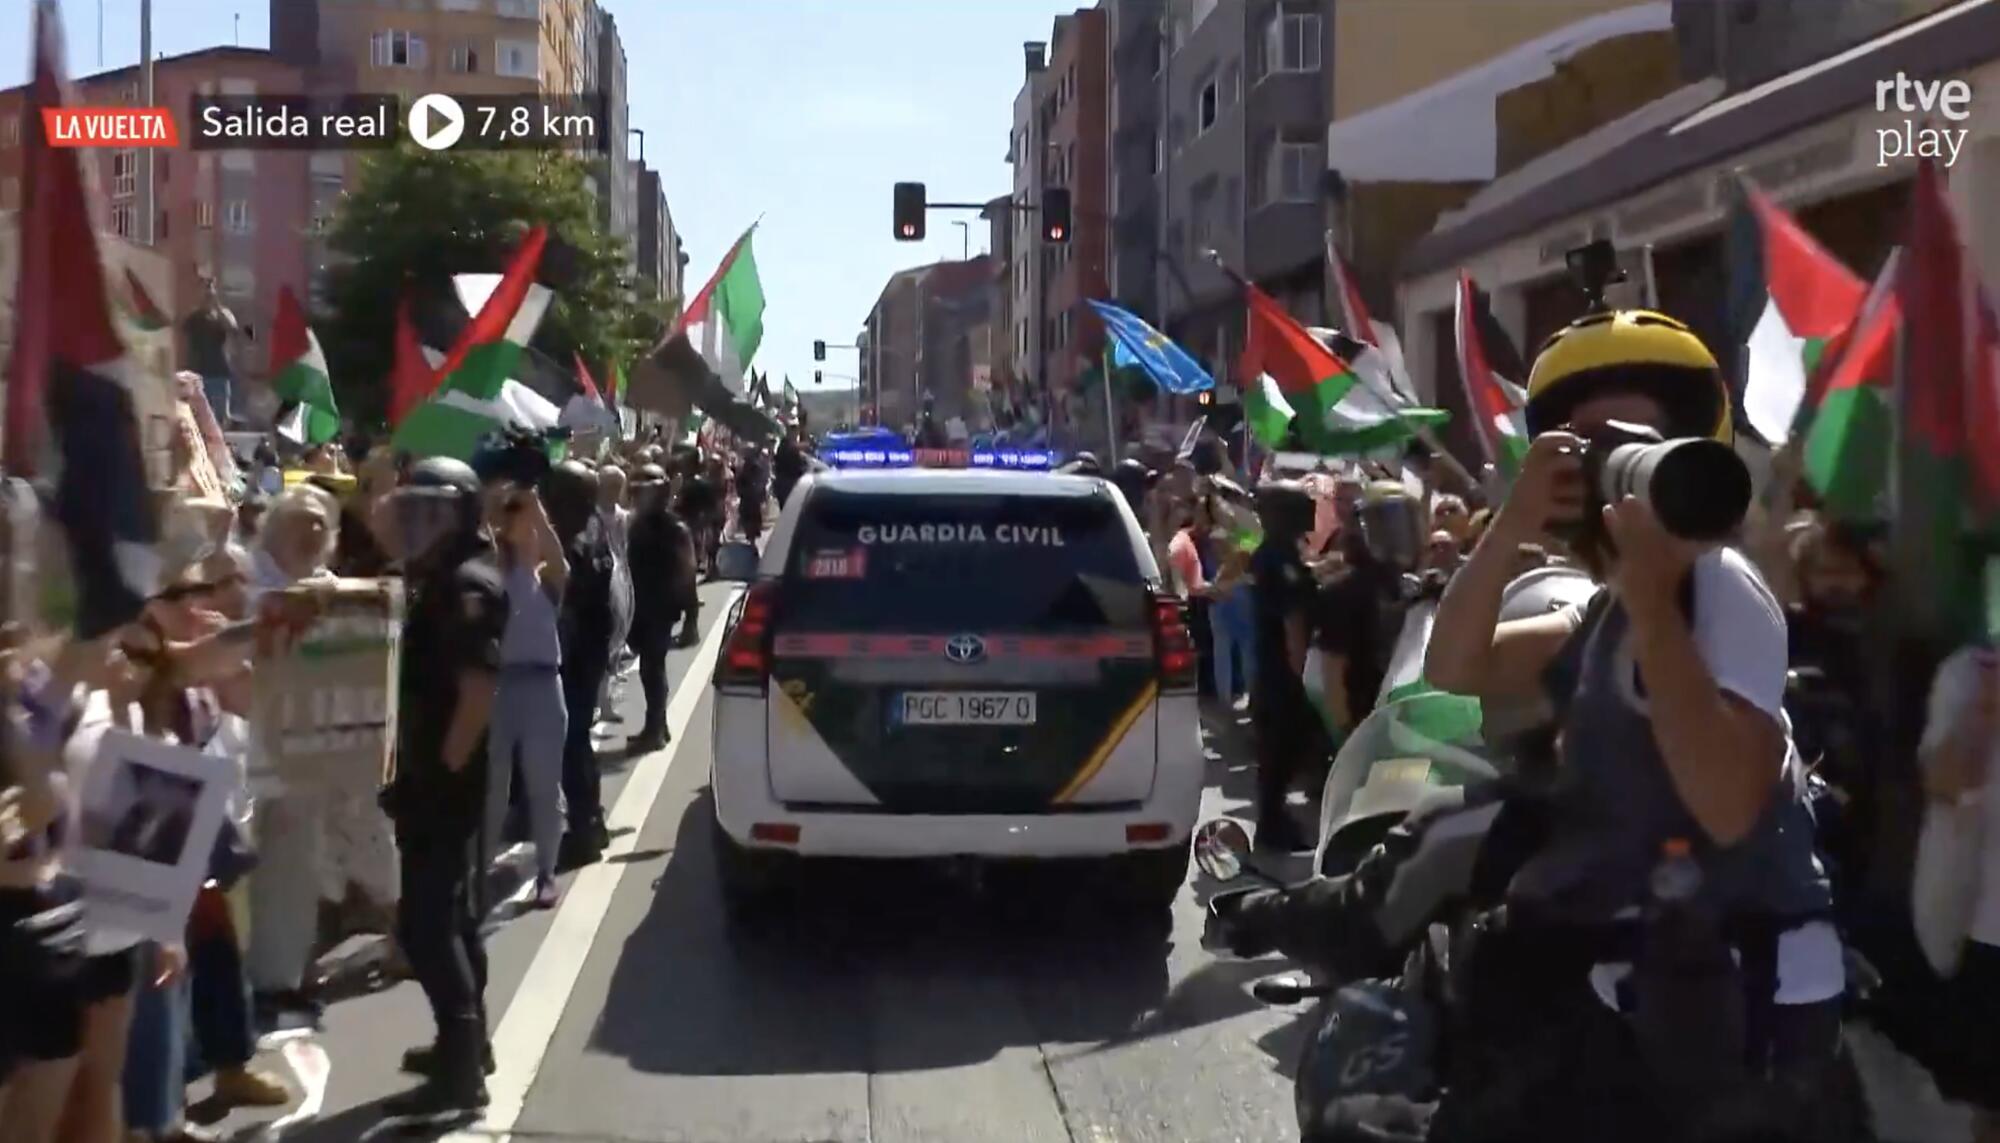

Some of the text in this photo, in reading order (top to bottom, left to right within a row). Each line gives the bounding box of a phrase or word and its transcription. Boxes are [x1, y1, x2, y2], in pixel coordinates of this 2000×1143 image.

[857, 525, 1065, 546] GUARDIA CIVIL
[904, 697, 948, 719] PGC
[957, 697, 1010, 719] 1967
